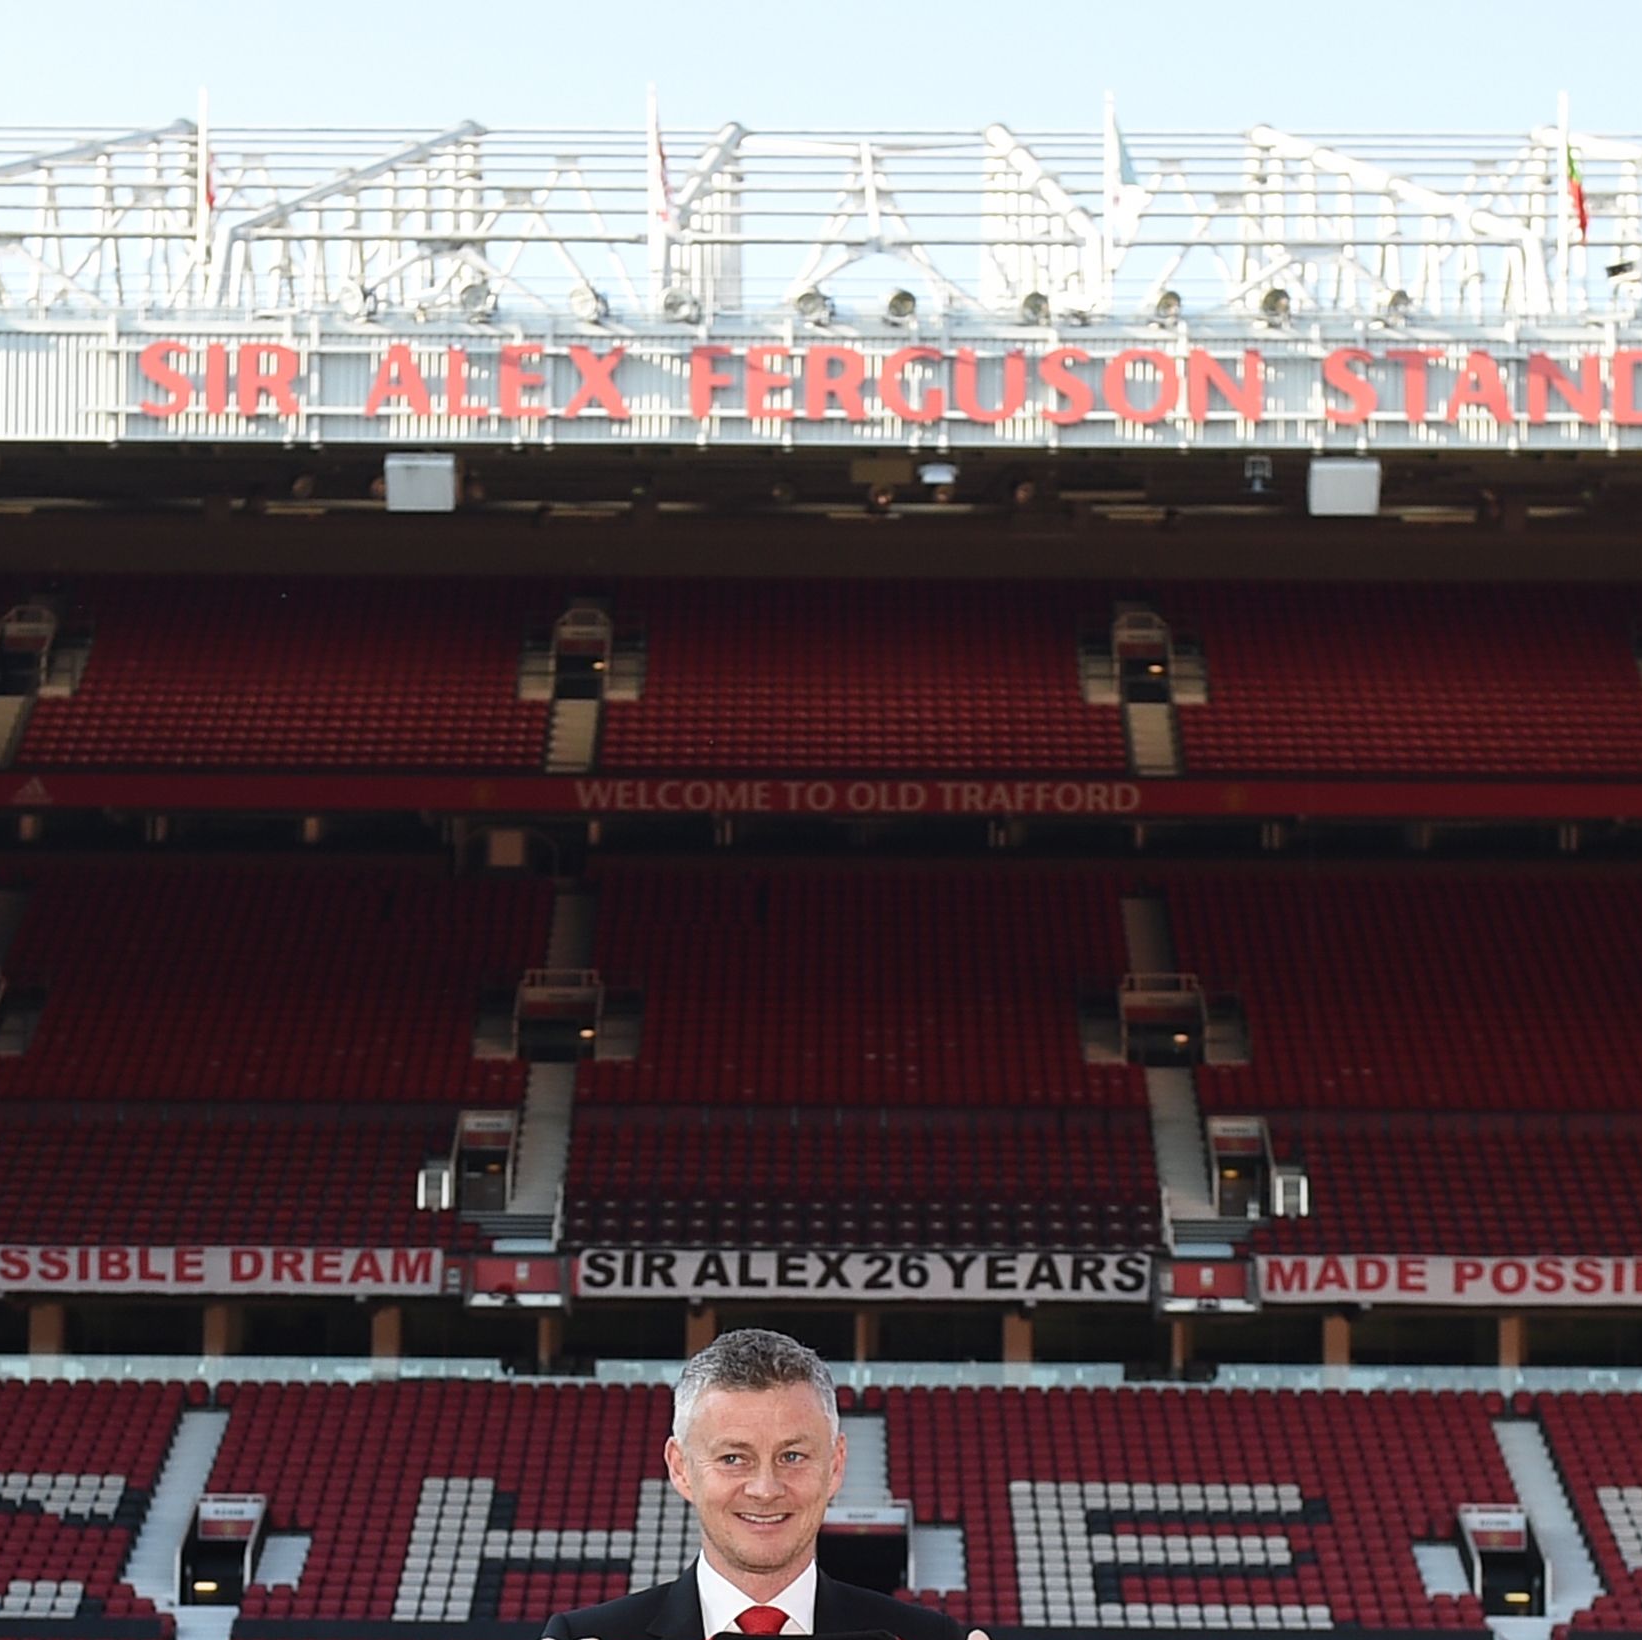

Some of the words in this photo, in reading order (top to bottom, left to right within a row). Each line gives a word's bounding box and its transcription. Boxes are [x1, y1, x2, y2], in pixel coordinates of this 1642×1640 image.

[138, 341, 300, 418] SIR
[365, 344, 630, 420] ALEX
[689, 346, 1264, 424] FERGUSON
[575, 780, 770, 810] WELCOME
[783, 781, 836, 811] TO
[847, 781, 928, 811] OLD
[938, 782, 1141, 812] TRAFFORD
[229, 1247, 434, 1285] DREAM
[582, 1250, 677, 1288] SIR
[692, 1251, 852, 1289] ALEX
[863, 1253, 929, 1291] 26
[941, 1254, 1147, 1293] YEARS
[1265, 1255, 1428, 1293] MADE
